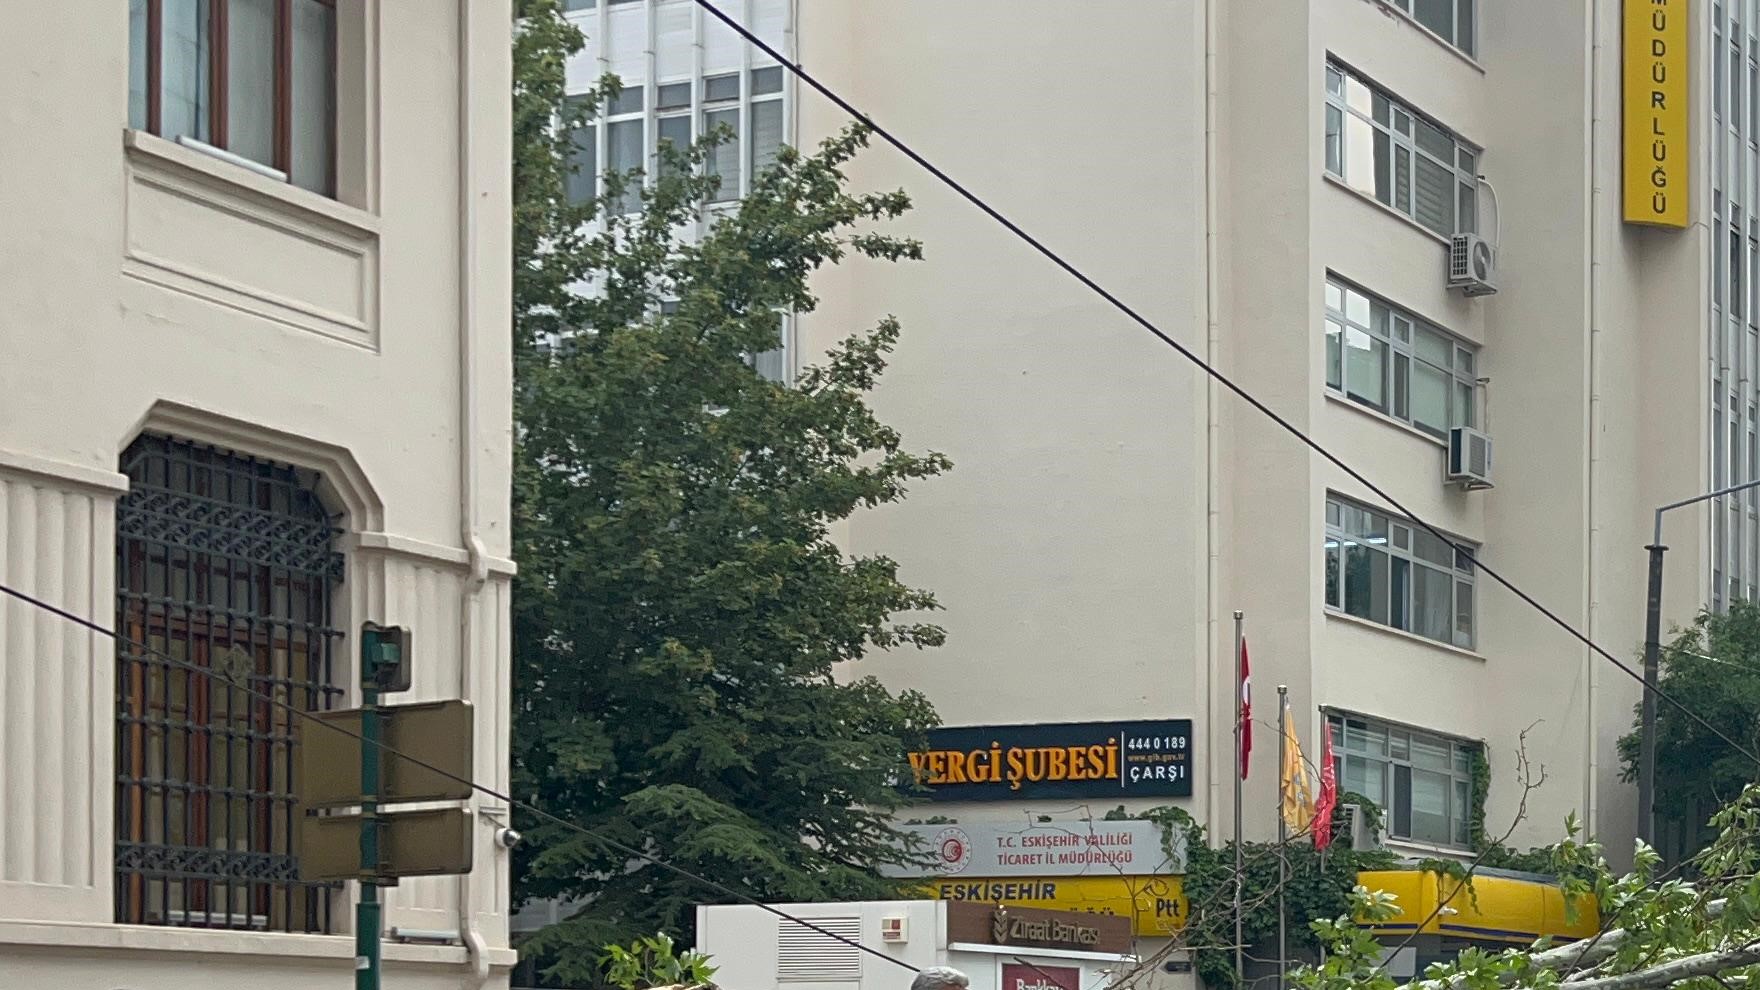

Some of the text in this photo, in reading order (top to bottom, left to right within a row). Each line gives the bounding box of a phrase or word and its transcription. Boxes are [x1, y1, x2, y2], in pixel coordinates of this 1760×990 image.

[1651, 0, 1667, 214] ÜDÜRLÜĞÜ
[1128, 738, 1151, 750] 444
[1164, 736, 1186, 749] 189
[907, 737, 1118, 790] VERGİ ŞUBESİ
[1130, 765, 1184, 783] ÇARŞI
[997, 832, 1133, 849] T.C. ESKİŞEHİR VALİLİĞİ
[997, 850, 1133, 865] TİCARET İL MÜDÜRLÜĞÜ
[1010, 915, 1049, 941] Ziraat
